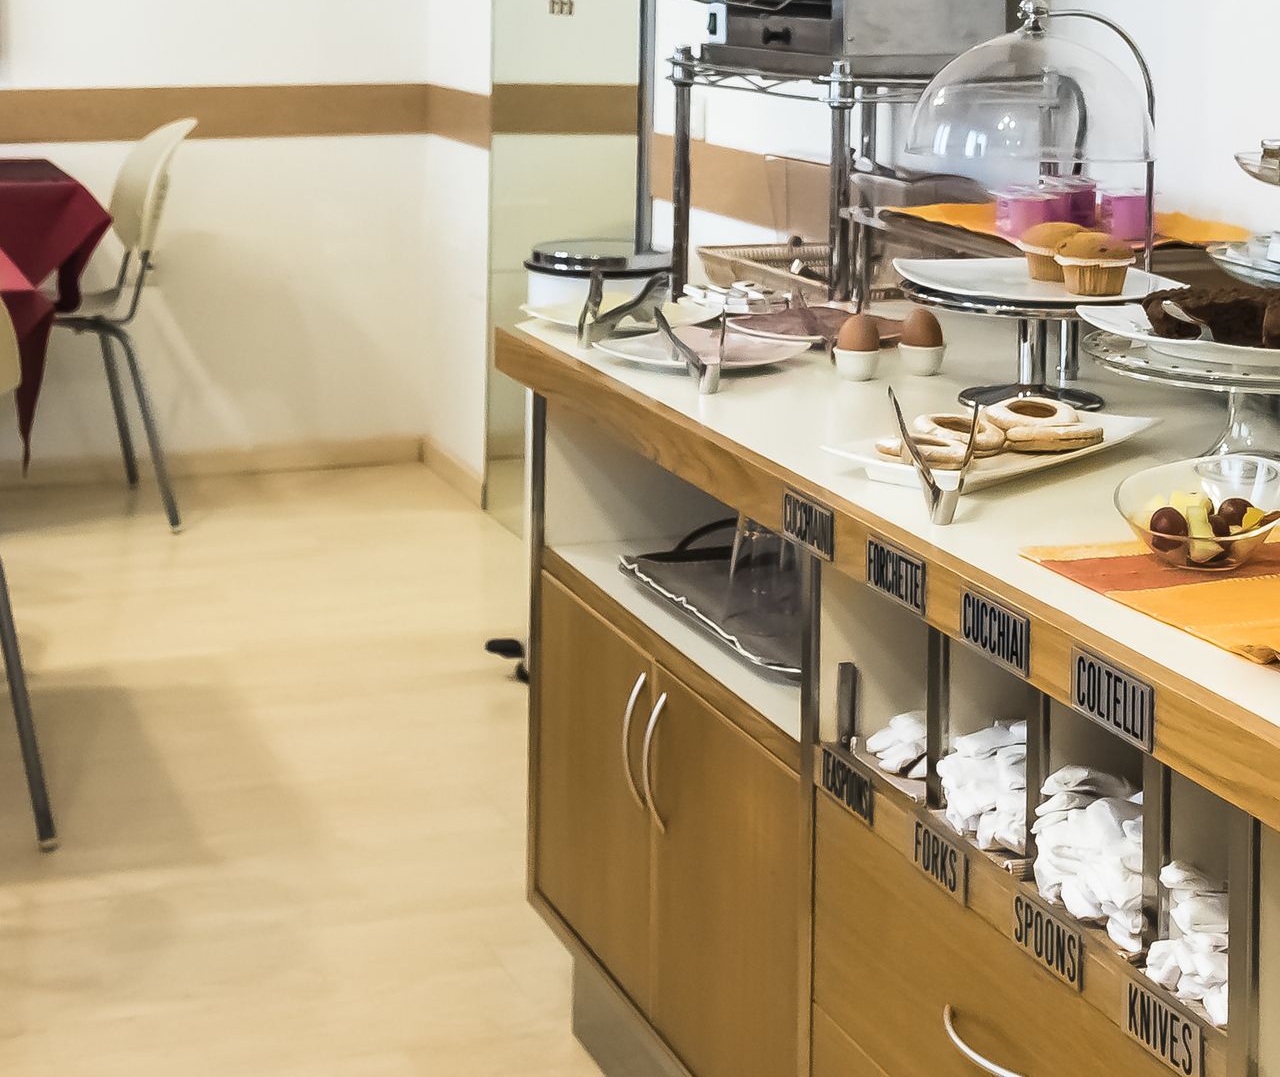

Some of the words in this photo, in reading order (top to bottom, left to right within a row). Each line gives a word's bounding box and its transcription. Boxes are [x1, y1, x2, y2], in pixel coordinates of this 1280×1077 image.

[867, 539, 922, 611] FORCHETTE
[962, 592, 1024, 671] CUCCHIAI
[1076, 651, 1147, 744] COLTELLI
[914, 823, 958, 893] FORKS
[1014, 896, 1077, 982] SPOONS
[1127, 983, 1193, 1076] KNIVES
